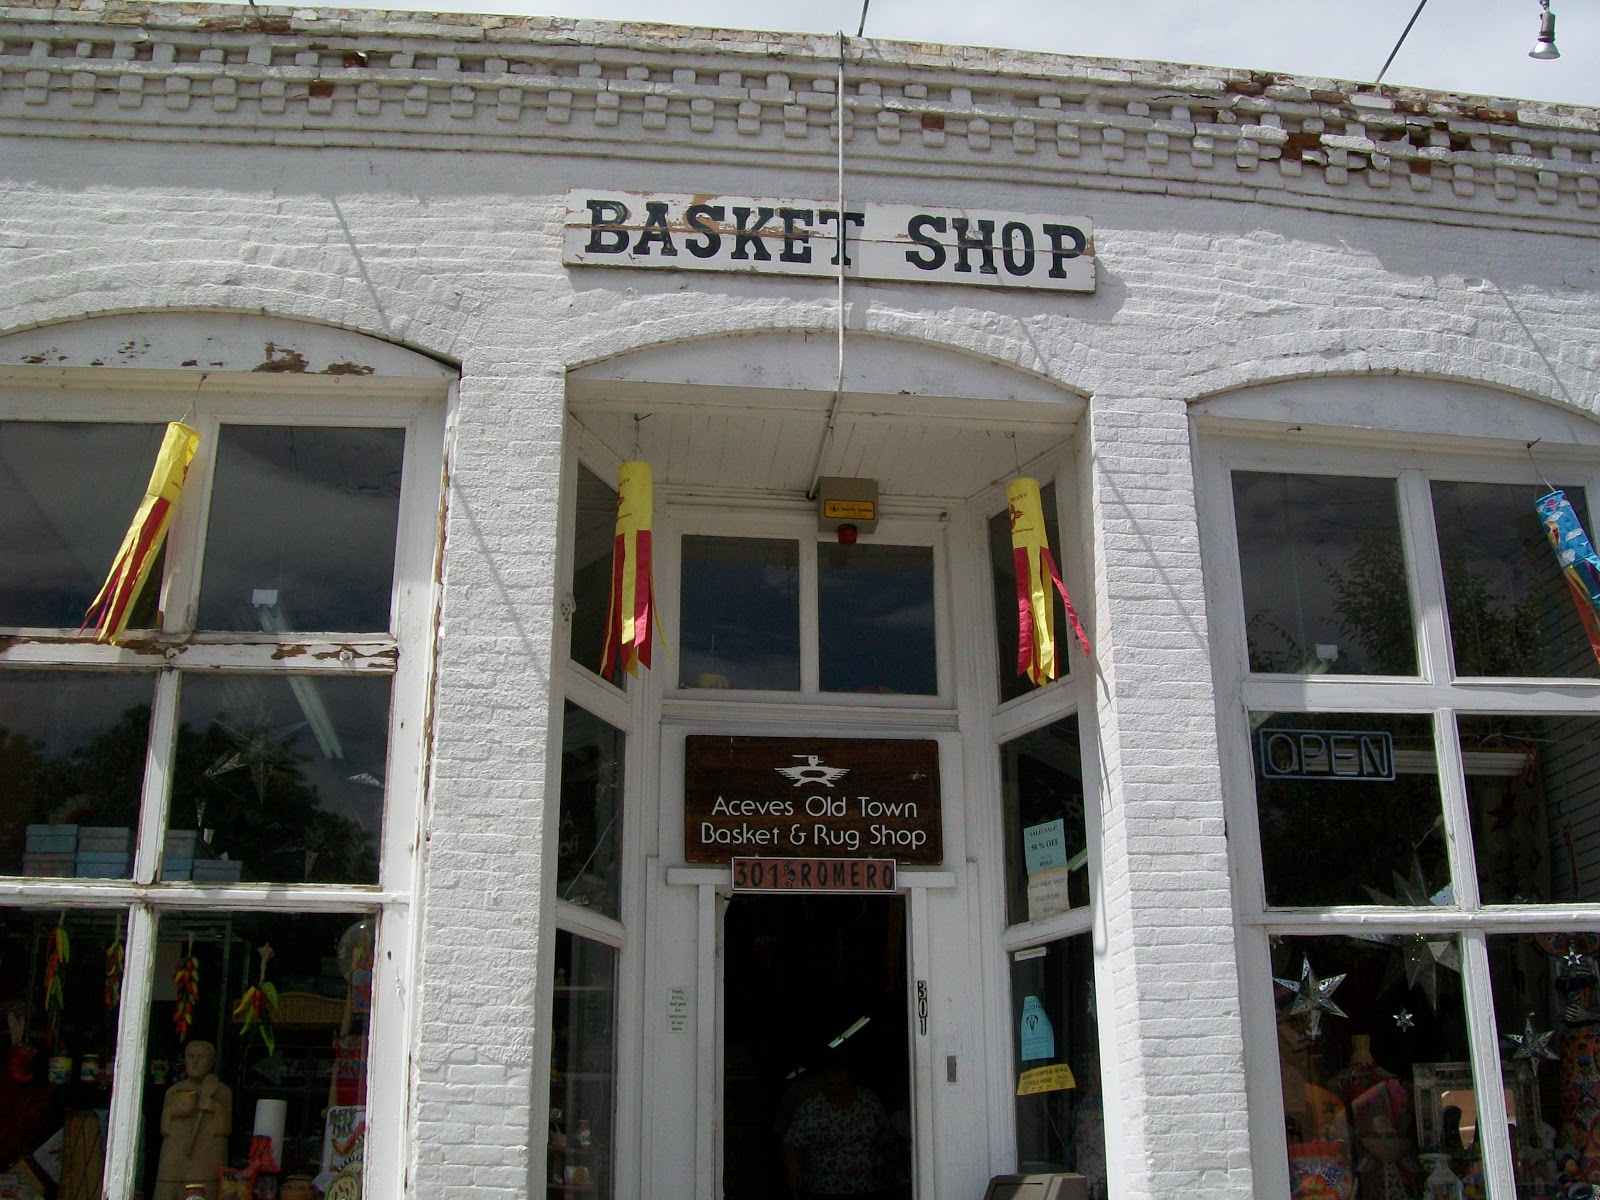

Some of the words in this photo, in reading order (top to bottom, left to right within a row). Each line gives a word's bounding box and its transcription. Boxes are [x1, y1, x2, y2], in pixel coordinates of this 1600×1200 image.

[585, 199, 864, 266] BASKET
[905, 214, 1087, 279] SHOP
[1267, 733, 1389, 776] OPEN
[711, 795, 794, 816] Aceves
[805, 796, 847, 817] Old
[857, 797, 918, 818] Town
[701, 822, 780, 845] Basket
[789, 824, 807, 845] &
[814, 825, 860, 850] Rug
[869, 825, 927, 850] Shop
[734, 861, 778, 888] 301
[801, 861, 894, 890] ROMERO
[917, 980, 928, 1036] 301
